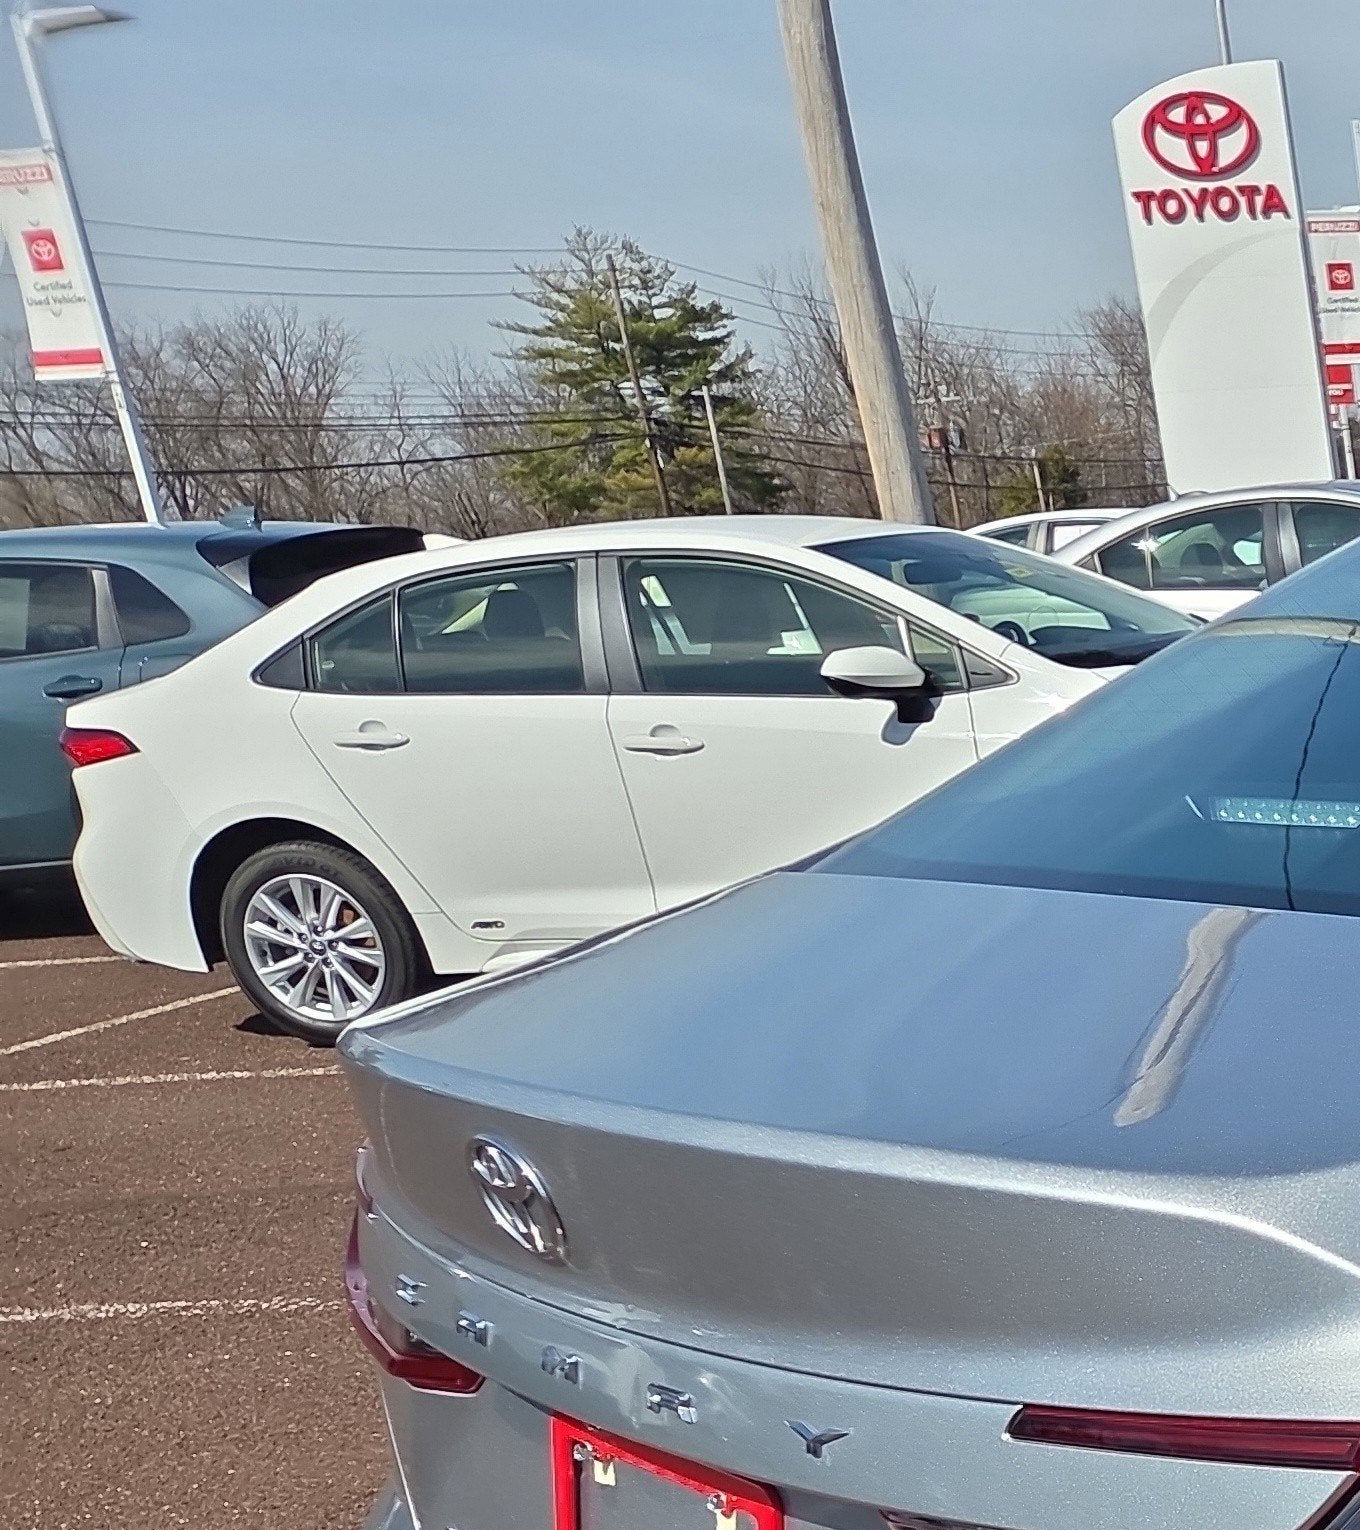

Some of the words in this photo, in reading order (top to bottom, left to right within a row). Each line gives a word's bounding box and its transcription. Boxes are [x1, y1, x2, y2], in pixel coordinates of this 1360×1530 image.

[1131, 184, 1291, 226] TOYOTA
[33, 279, 73, 291] Certified
[27, 295, 50, 306] Used
[51, 293, 86, 304] Vehicles
